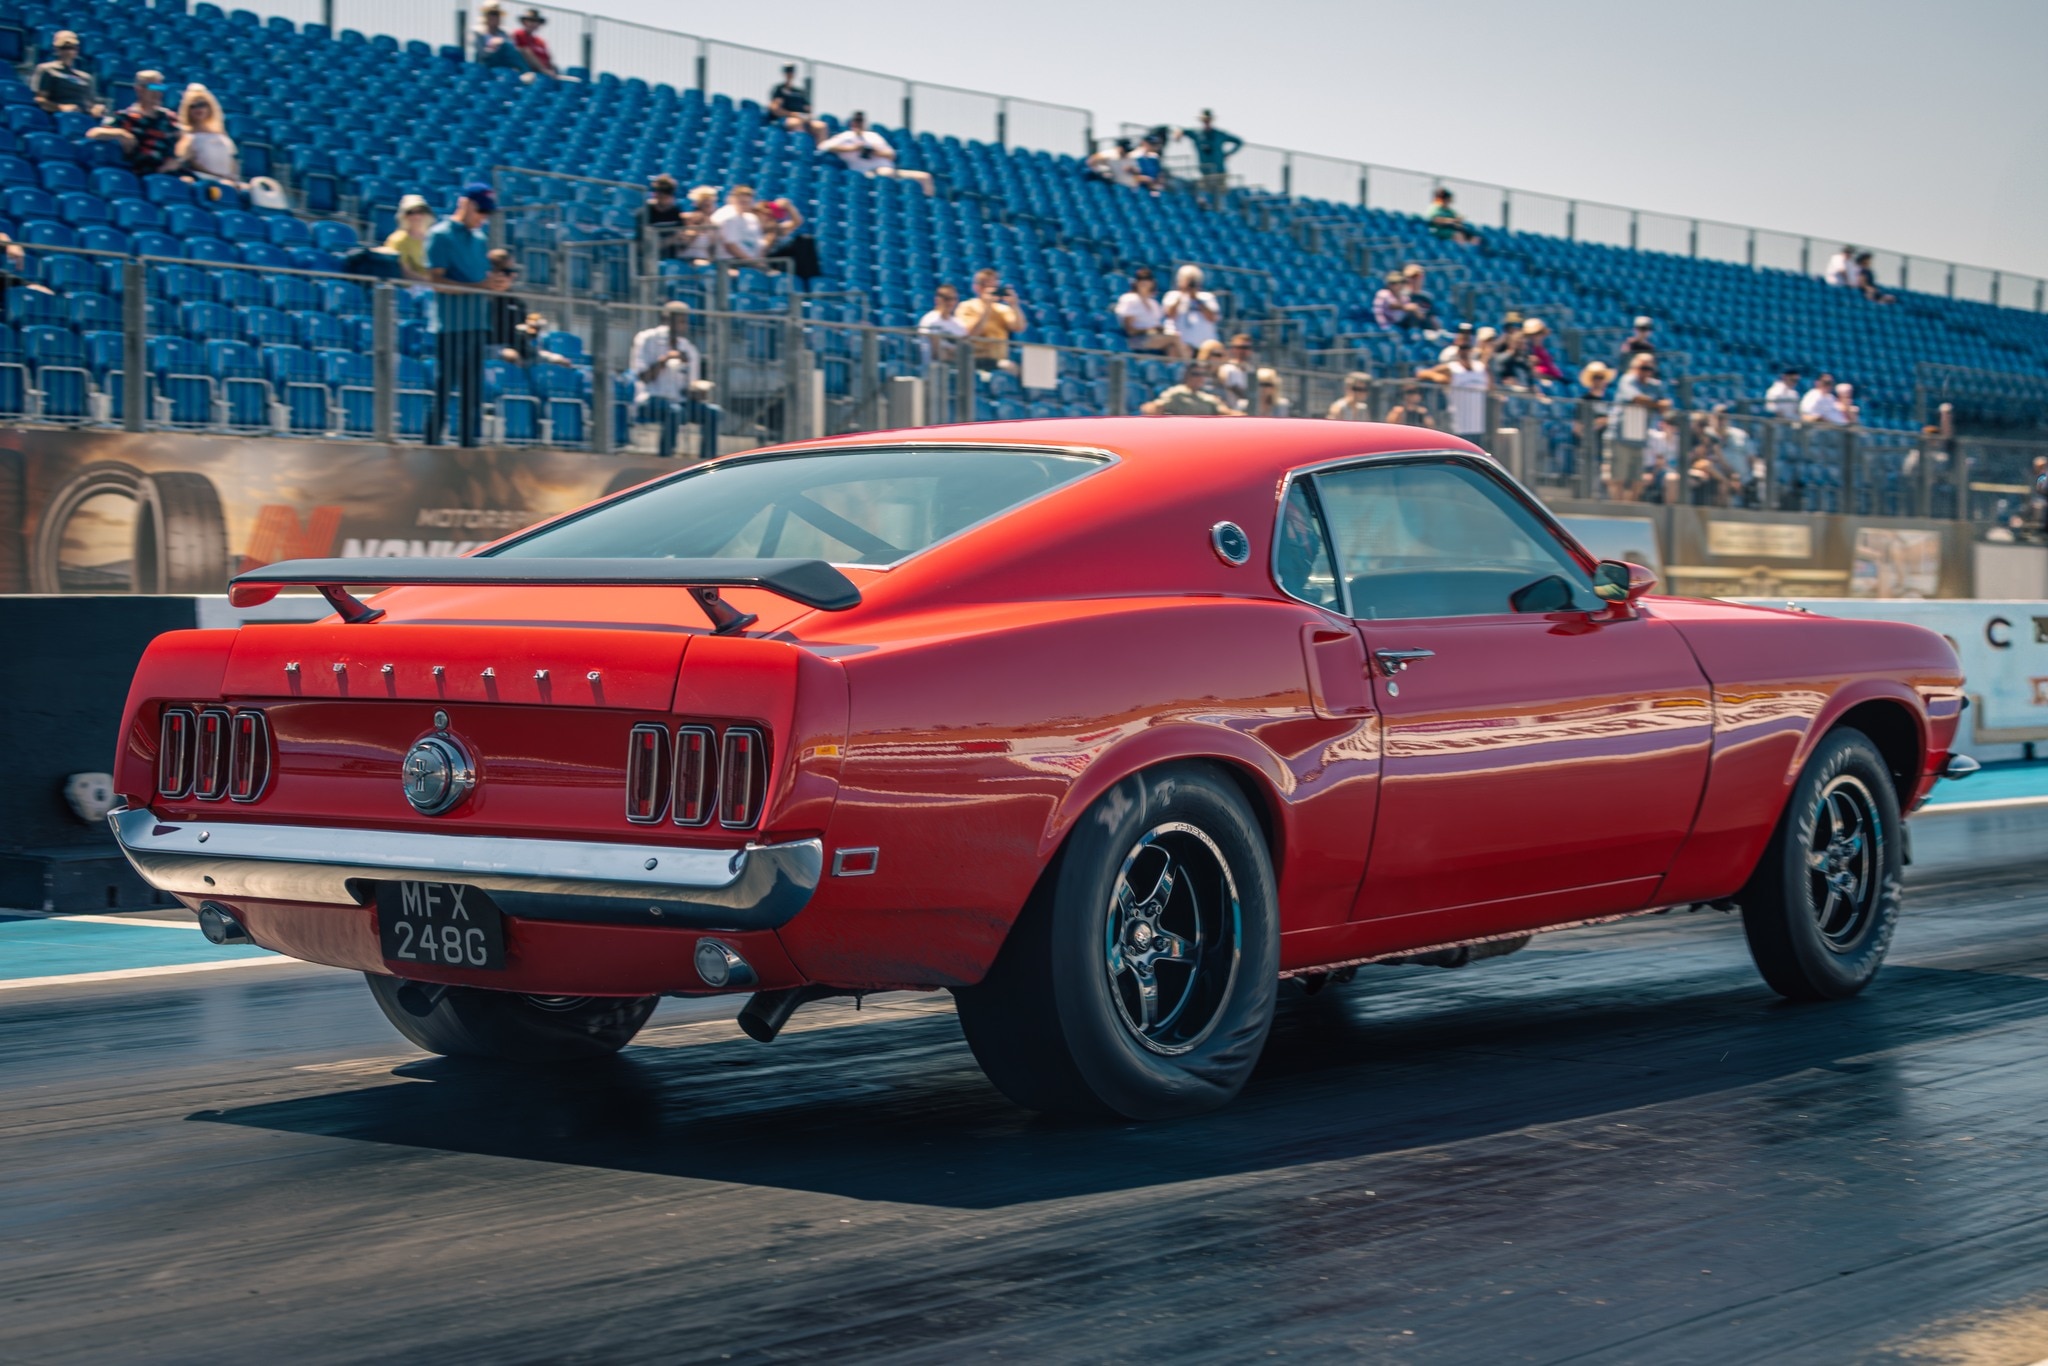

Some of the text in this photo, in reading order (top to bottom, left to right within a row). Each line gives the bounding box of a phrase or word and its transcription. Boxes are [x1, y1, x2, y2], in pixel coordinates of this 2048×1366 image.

[284, 661, 601, 682] MUSTANG
[401, 881, 470, 920] MFX
[394, 921, 488, 966] 248G
